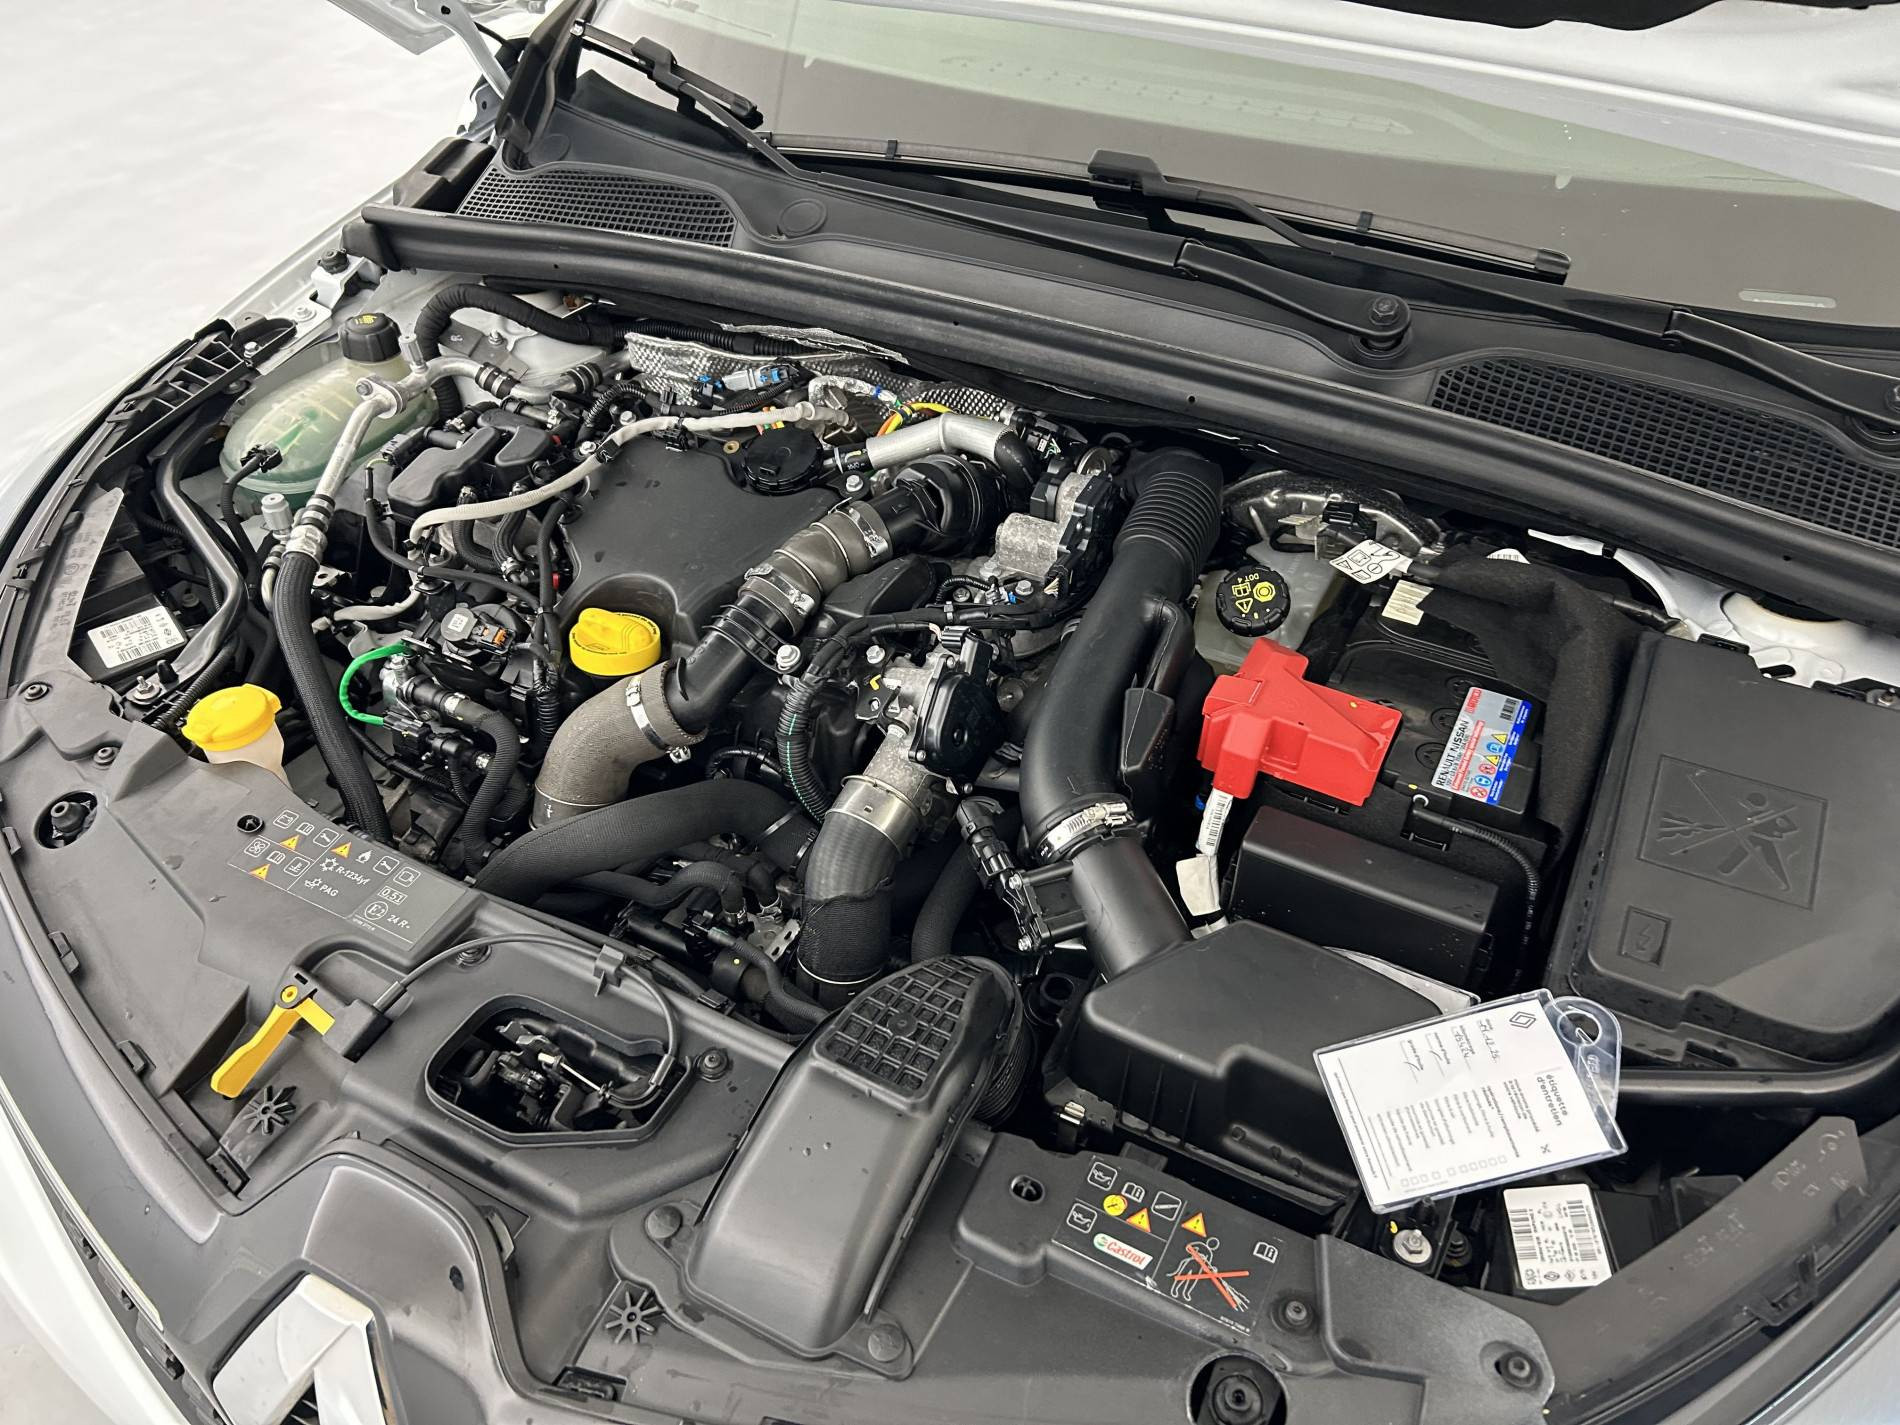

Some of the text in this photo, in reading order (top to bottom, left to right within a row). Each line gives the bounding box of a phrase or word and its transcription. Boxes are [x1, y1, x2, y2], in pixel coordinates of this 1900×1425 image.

[1245, 573, 1259, 582] DOT
[1436, 754, 1455, 786] RENAULT
[1451, 720, 1469, 753] NISSAN
[335, 866, 370, 886] R-1234yf
[319, 884, 339, 897] PAG
[387, 914, 400, 924] 24
[1536, 1075, 1562, 1127] d'entretien
[1545, 1073, 1568, 1116] étiquette
[1106, 1239, 1147, 1267] Castrol
